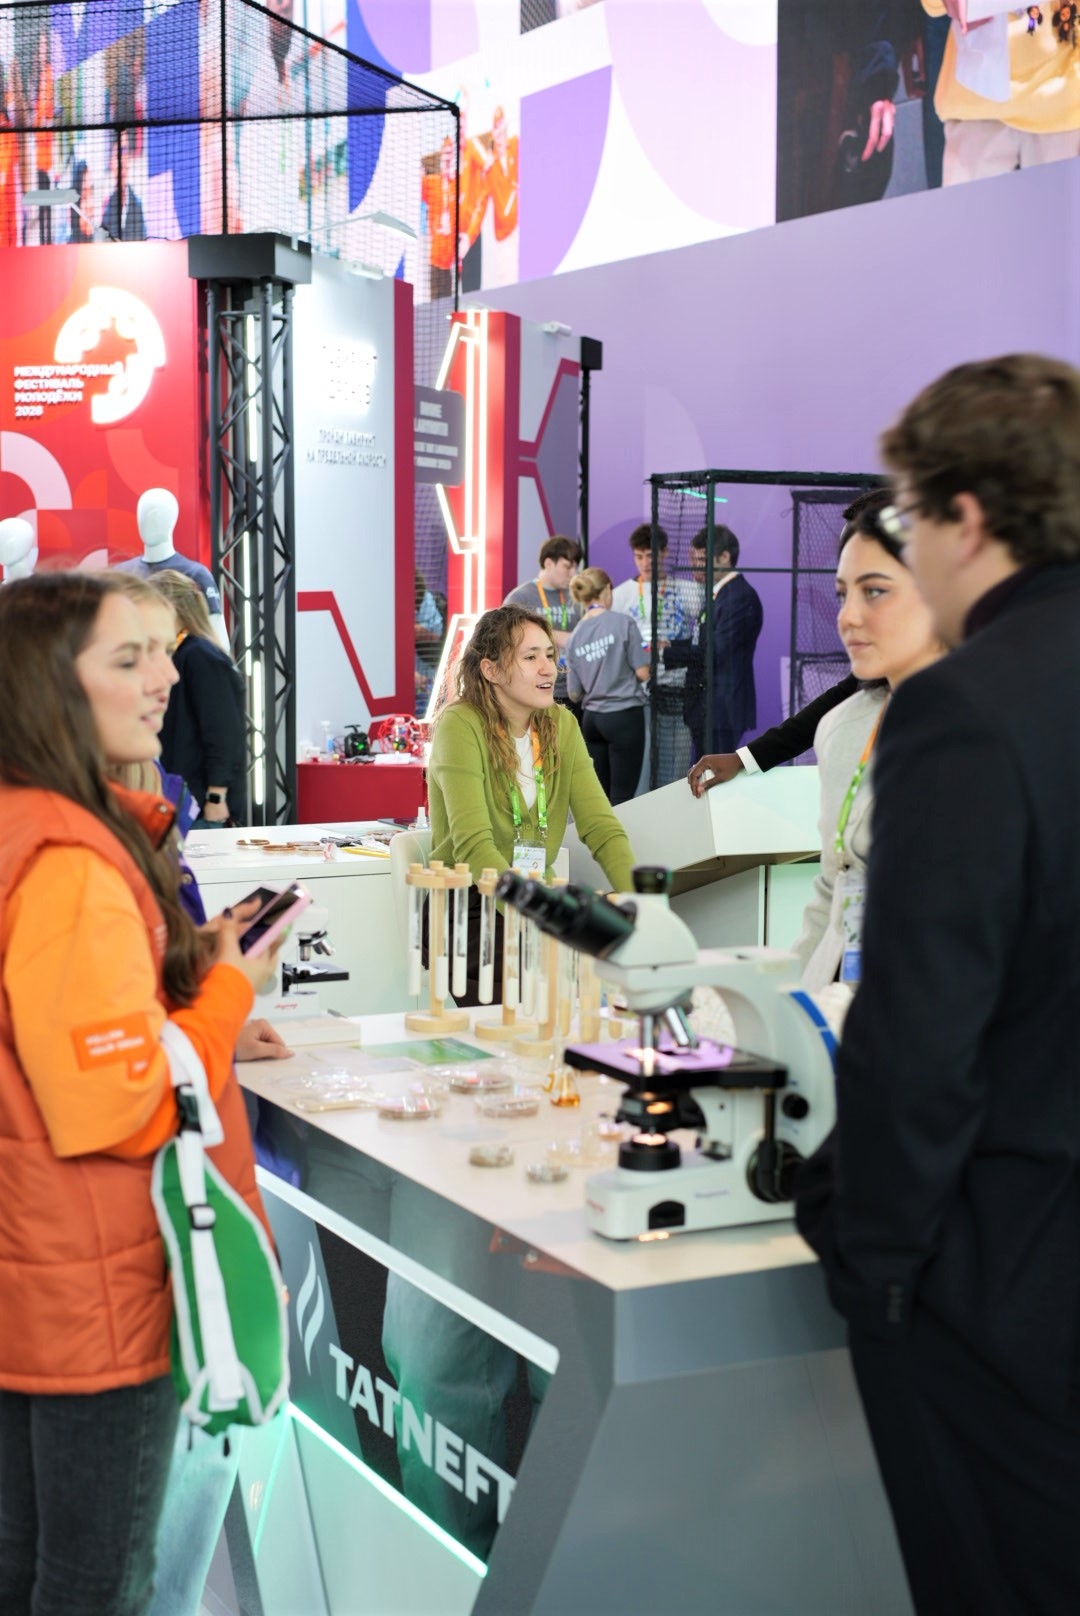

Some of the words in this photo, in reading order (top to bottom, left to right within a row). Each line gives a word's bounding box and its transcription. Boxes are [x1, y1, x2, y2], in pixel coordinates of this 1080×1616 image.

[14, 361, 124, 378] МЕЖДУНАРОДНЫЙ
[14, 378, 84, 390] ФЕСТИВАЛЬ
[329, 1343, 517, 1524] TATNEFT
